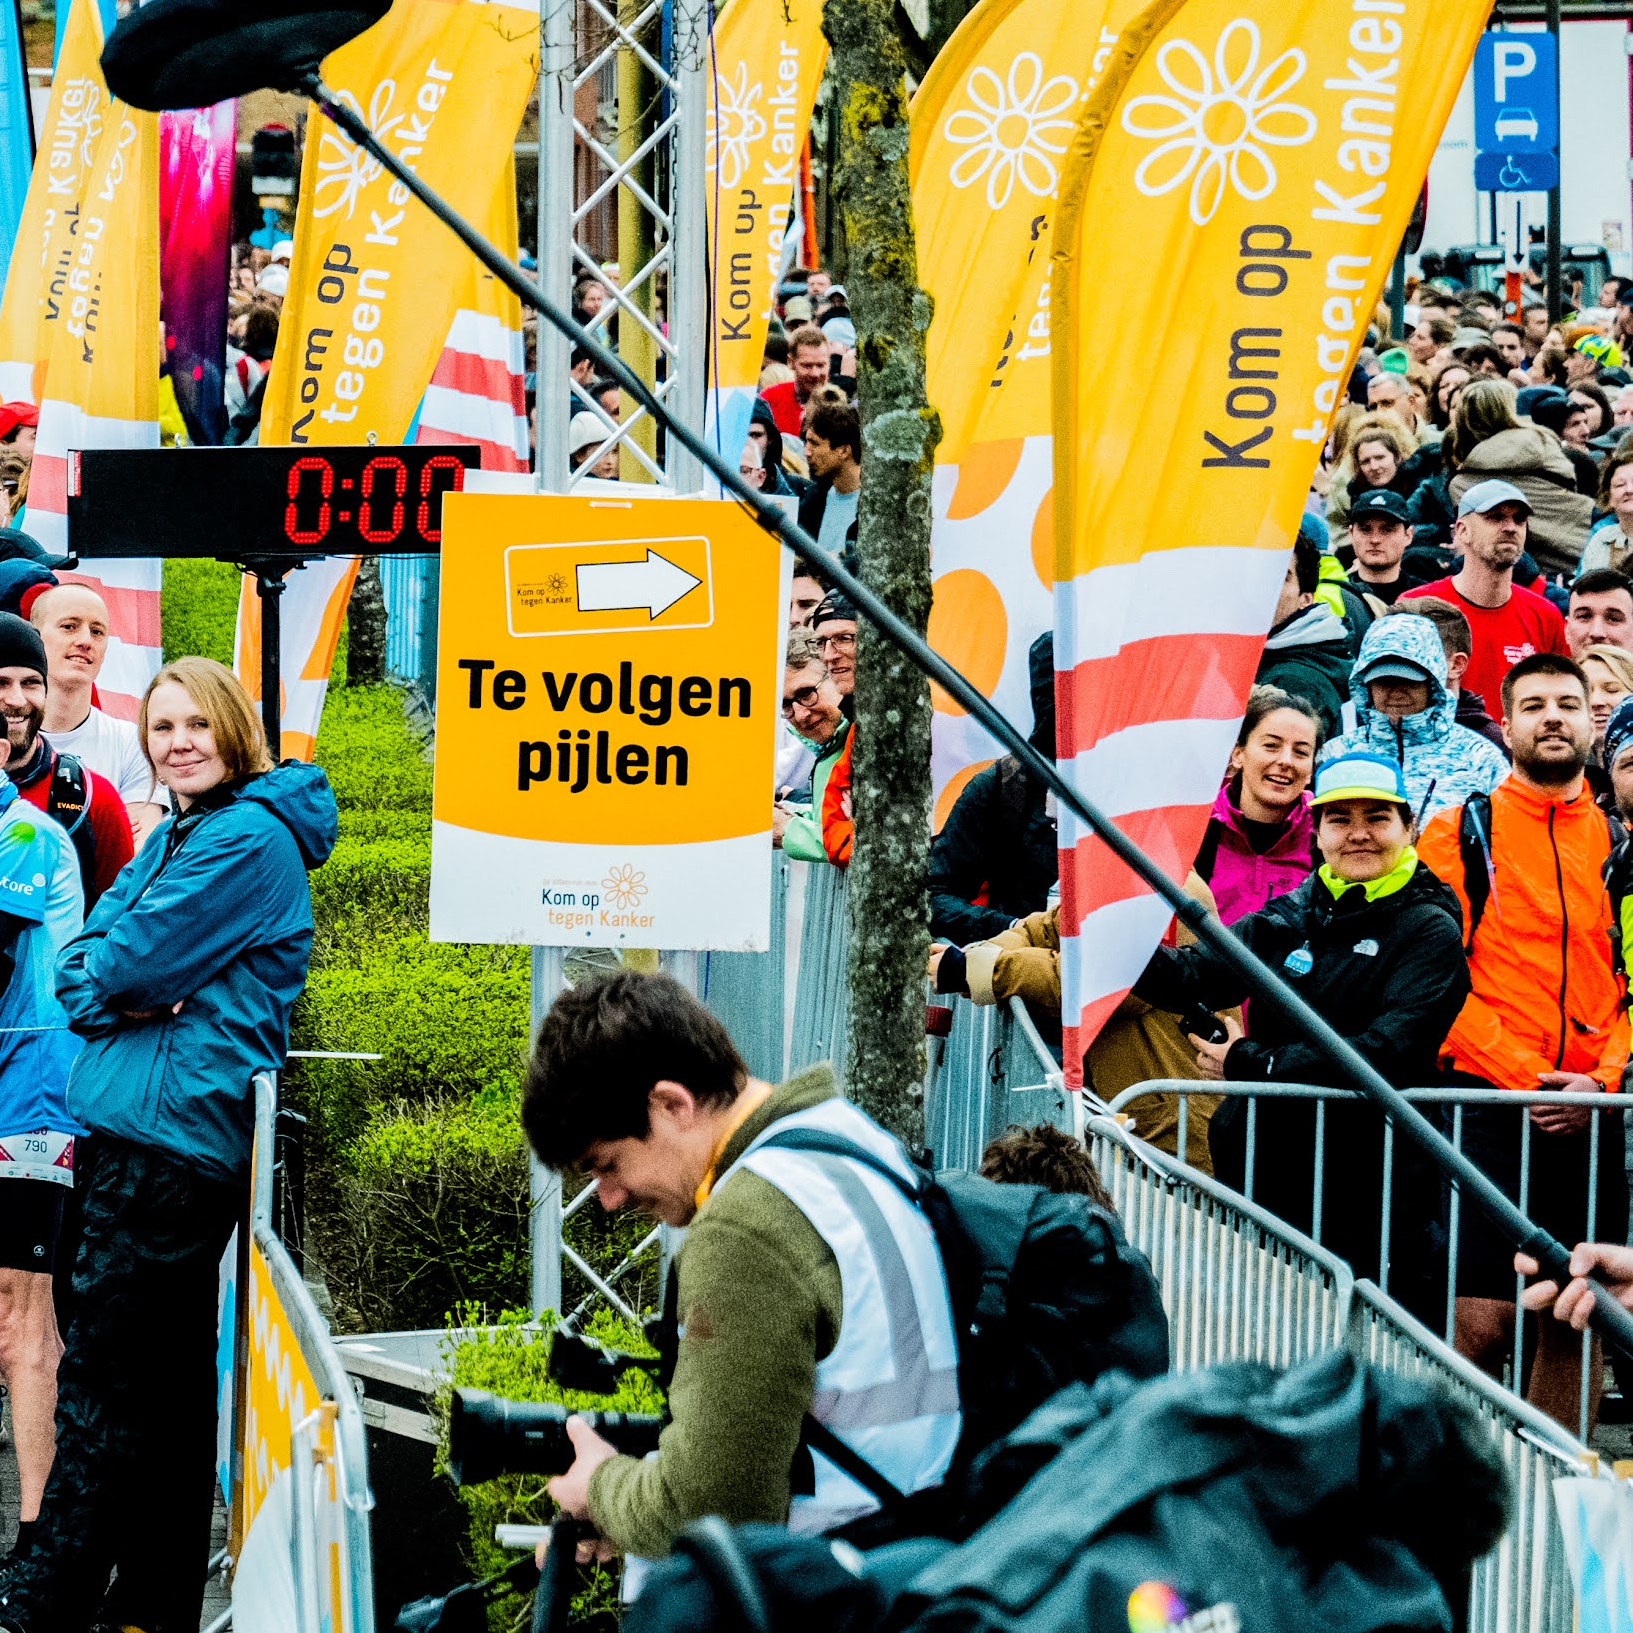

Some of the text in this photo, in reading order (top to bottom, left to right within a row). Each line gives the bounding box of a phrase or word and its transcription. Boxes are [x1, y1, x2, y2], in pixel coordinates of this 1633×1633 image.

[1493, 41, 1536, 103] P
[762, 40, 799, 186] Kanker
[317, 241, 354, 305] op
[322, 267, 389, 424] tegen
[1202, 224, 1311, 468] Kom op
[516, 587, 545, 598] Kom op
[520, 596, 573, 607] tegen Kanker
[458, 658, 752, 726] Te volgen
[517, 730, 689, 794] pijlen
[542, 888, 599, 911] Kom op
[548, 908, 655, 929] tegen Kanker
[24, 1139, 48, 1153] 790
